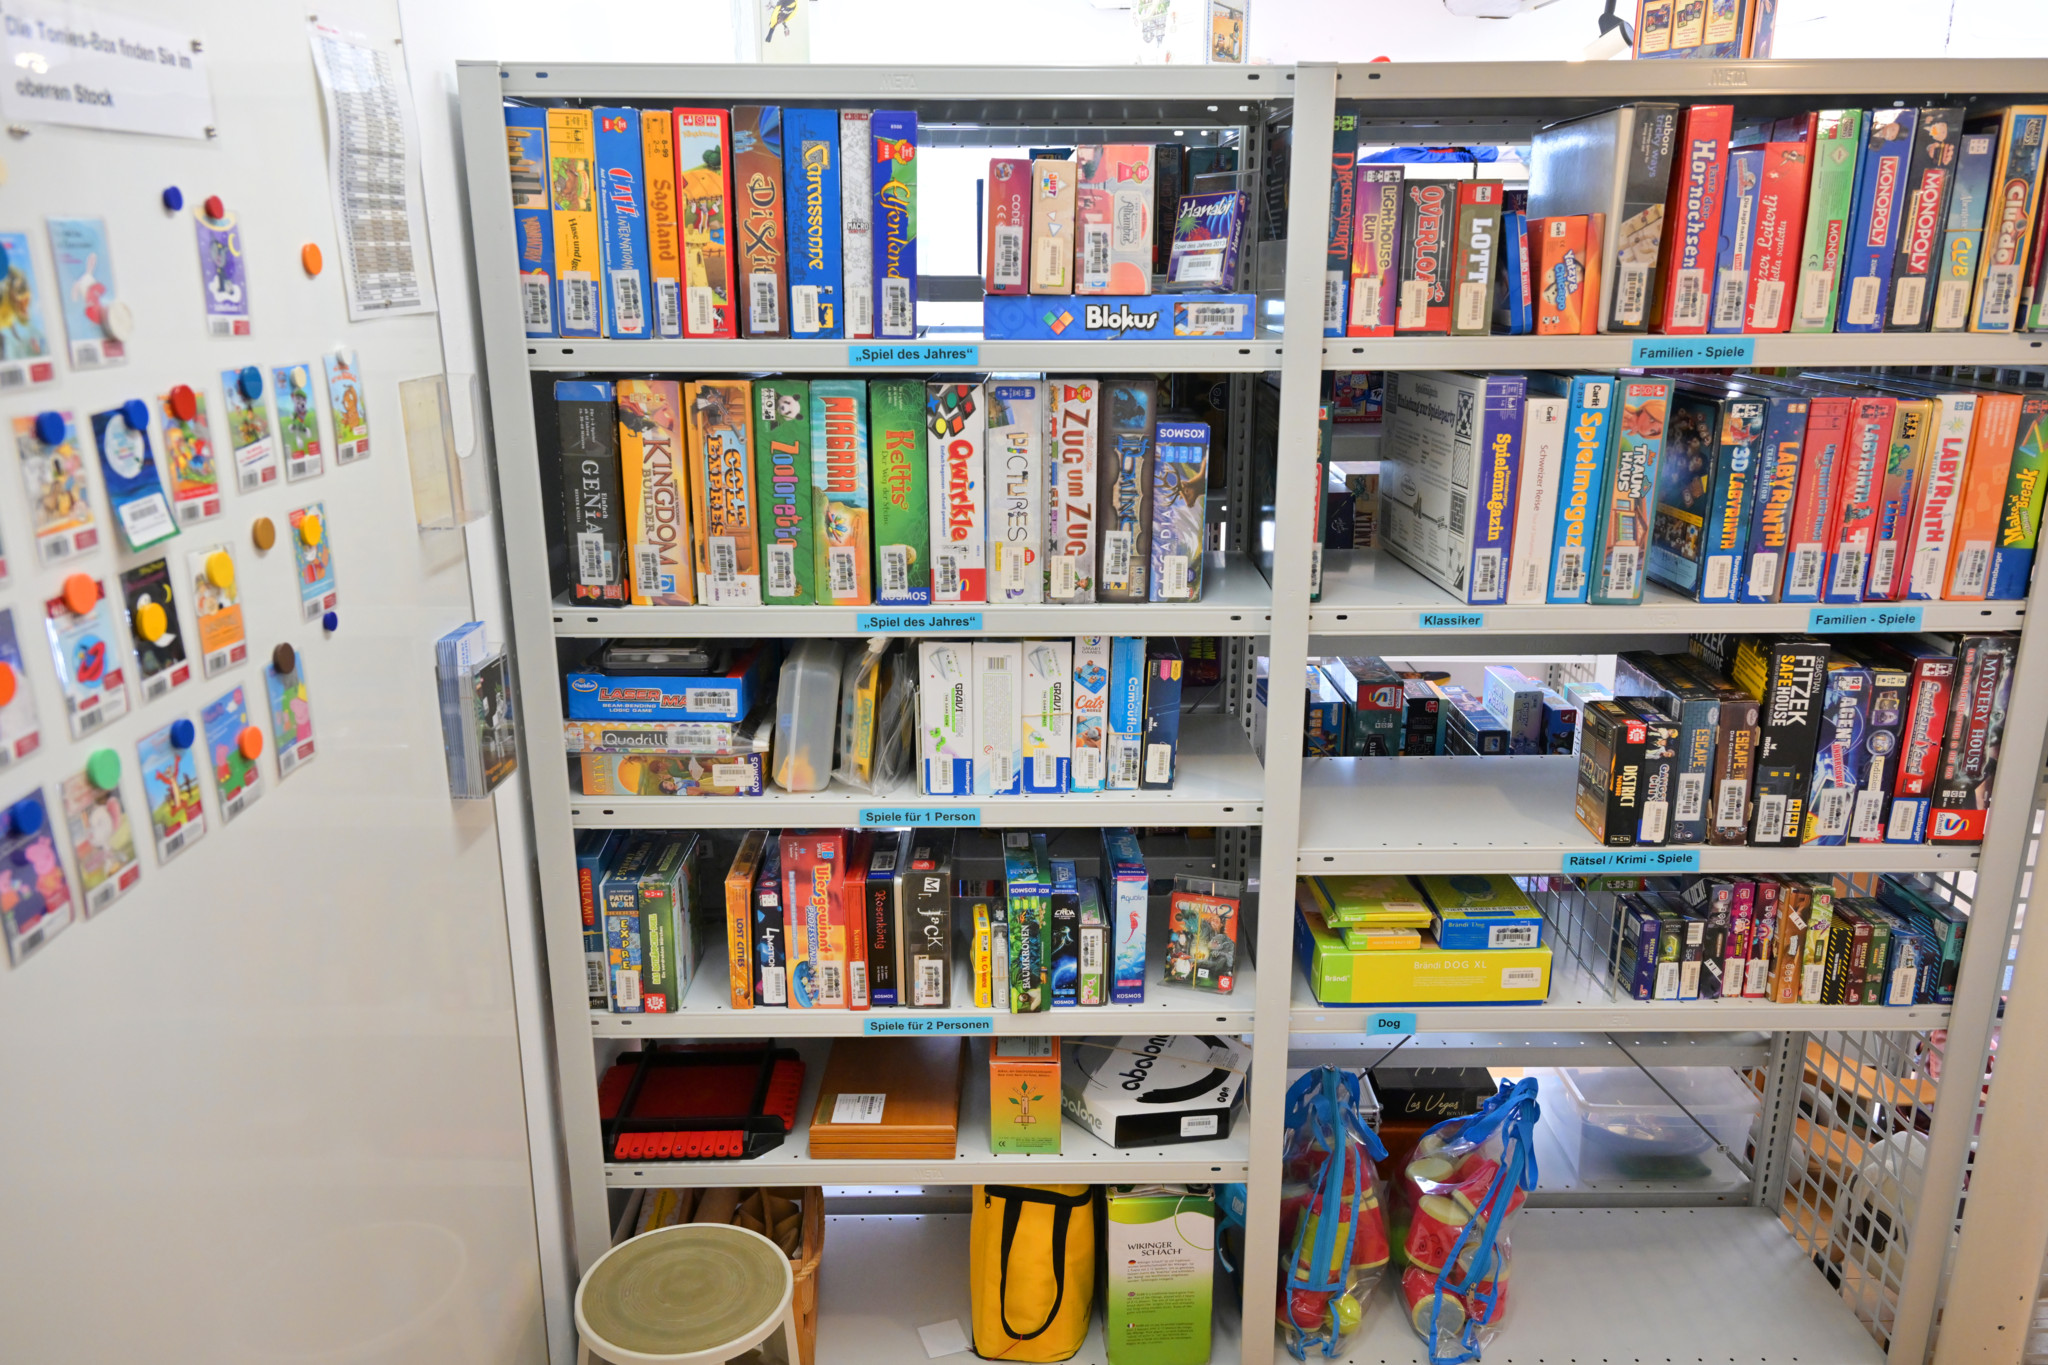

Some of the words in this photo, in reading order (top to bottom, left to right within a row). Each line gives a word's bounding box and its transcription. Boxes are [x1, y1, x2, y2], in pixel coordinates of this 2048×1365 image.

[119, 38, 156, 62] finden
[158, 46, 177, 66] Sie
[179, 52, 192, 69] im
[15, 79, 72, 102] oberen
[74, 83, 114, 107] Stock
[1652, 114, 1665, 147] tricky
[1660, 115, 1673, 156] cuboro
[1649, 150, 1660, 178] ways
[1708, 164, 1719, 193] Tanz
[805, 144, 827, 270] Carcassonne
[1180, 199, 1232, 219] Hanabi
[1684, 140, 1716, 270] Hornochsen
[1703, 196, 1715, 219] der
[1740, 209, 1748, 225] Jagd
[1871, 160, 1895, 244] MONOPOLY
[650, 179, 675, 261] Sagaland
[879, 177, 910, 279] Elfenland
[1363, 214, 1378, 242] Run
[1739, 226, 1747, 241] nach
[1757, 195, 1778, 250] Leiterli
[1911, 172, 1943, 273] MONOPOLY
[1998, 185, 2024, 264] Cluedo
[568, 218, 580, 240] Hase
[574, 240, 582, 258] und
[1194, 240, 1211, 249] Jahres
[1212, 239, 1225, 247] 2013
[1737, 242, 1745, 253] der
[1555, 263, 1567, 311] Chicago
[1086, 304, 1159, 334] Blokus
[855, 348, 895, 361] „Spiel
[898, 348, 920, 360] des
[923, 347, 973, 359] Jahres“
[1640, 346, 1693, 359] Familien
[1705, 346, 1745, 360] Spiele
[1590, 384, 1601, 407] Carlit
[822, 397, 859, 493] NIAGARA
[1062, 408, 1091, 464] ZUG
[1160, 427, 1205, 439] KOSMOS
[881, 450, 889, 464] Der
[886, 430, 915, 510] Keltis
[1536, 445, 1549, 488] Schweizer
[1617, 452, 1633, 492] HAUS
[1628, 445, 1648, 498] TRAUM
[1731, 447, 1750, 472] 3D
[1853, 423, 1880, 503] LABYRINTH
[1928, 451, 1939, 494] SWITZERLAND
[881, 468, 889, 485] Weg
[882, 486, 890, 500] der
[947, 439, 975, 542] Qwirkle
[1487, 433, 1512, 541] Spielemagazin
[1923, 438, 1962, 543] LABYRINTH
[641, 468, 655, 535] BUILDER
[642, 438, 678, 566] KINGDOM
[1533, 489, 1543, 511] Reise
[1720, 472, 1745, 549] LABYRINTH
[1762, 441, 1799, 547] LABYRINTH
[2004, 505, 2025, 546] Make
[2016, 468, 2040, 510] Break
[1064, 503, 1092, 556] ZUG
[1498, 557, 1507, 599] Ravensburger
[1729, 555, 1741, 600] Ravensburger
[1988, 552, 2003, 597] Ravensburger
[880, 591, 928, 601] KOSMOS
[863, 617, 900, 630] „Spiel
[904, 617, 925, 628] des
[929, 616, 976, 628] Jahres“
[1424, 614, 1481, 626] Klassiker
[1815, 615, 1867, 627] Familien
[1878, 612, 1916, 627] Spiele
[1966, 648, 1976, 663] DAS
[1772, 654, 1795, 727] SAFEHOUSE
[1786, 655, 1816, 726] FITZEK
[1811, 656, 1825, 694] SEBASTIAN
[600, 688, 661, 700] LASER
[1074, 695, 1104, 709] Cats
[1976, 659, 1998, 725] MYSTERY
[1835, 697, 1857, 749] AGENT
[1694, 729, 1710, 767] ESCAPE
[1733, 730, 1750, 769] ESCAPE
[1965, 728, 1986, 773] HOUSE
[1831, 744, 1845, 788] UNDERCOVER
[1620, 765, 1638, 808] DISTRICT
[866, 812, 901, 823] Spiele
[904, 811, 922, 822] für
[925, 812, 930, 822] 1
[935, 812, 976, 822] Person
[1802, 816, 1814, 840] Piatnik
[1914, 800, 1928, 843] Ravensburger
[1934, 812, 1946, 836] Schmidt
[821, 842, 834, 859] MB
[1570, 854, 1606, 866] Rätsel
[1616, 853, 1647, 866] Krimi
[1656, 852, 1692, 866] Spiele
[918, 877, 940, 900] Mr.
[875, 890, 888, 950] Rosenkönig
[1219, 904, 1233, 919] 2
[736, 918, 744, 939] LOST
[737, 941, 746, 968] CITIES
[1022, 925, 1031, 989] BAUMKRONEN
[1414, 961, 1441, 970] Brändi
[1444, 961, 1469, 969] DOG
[1475, 960, 1487, 969] XL
[1325, 974, 1348, 982] Brändi
[870, 1020, 905, 1032] Spiele
[907, 1020, 924, 1031] für
[926, 1020, 934, 1031] 2
[936, 1019, 989, 1031] Personen
[1378, 1018, 1401, 1029] Dog
[1405, 1092, 1421, 1113] Las
[1425, 1092, 1459, 1115] Vegas
[1127, 1241, 1172, 1250] WIKINGER
[1141, 1248, 1181, 1257] SCHACH
